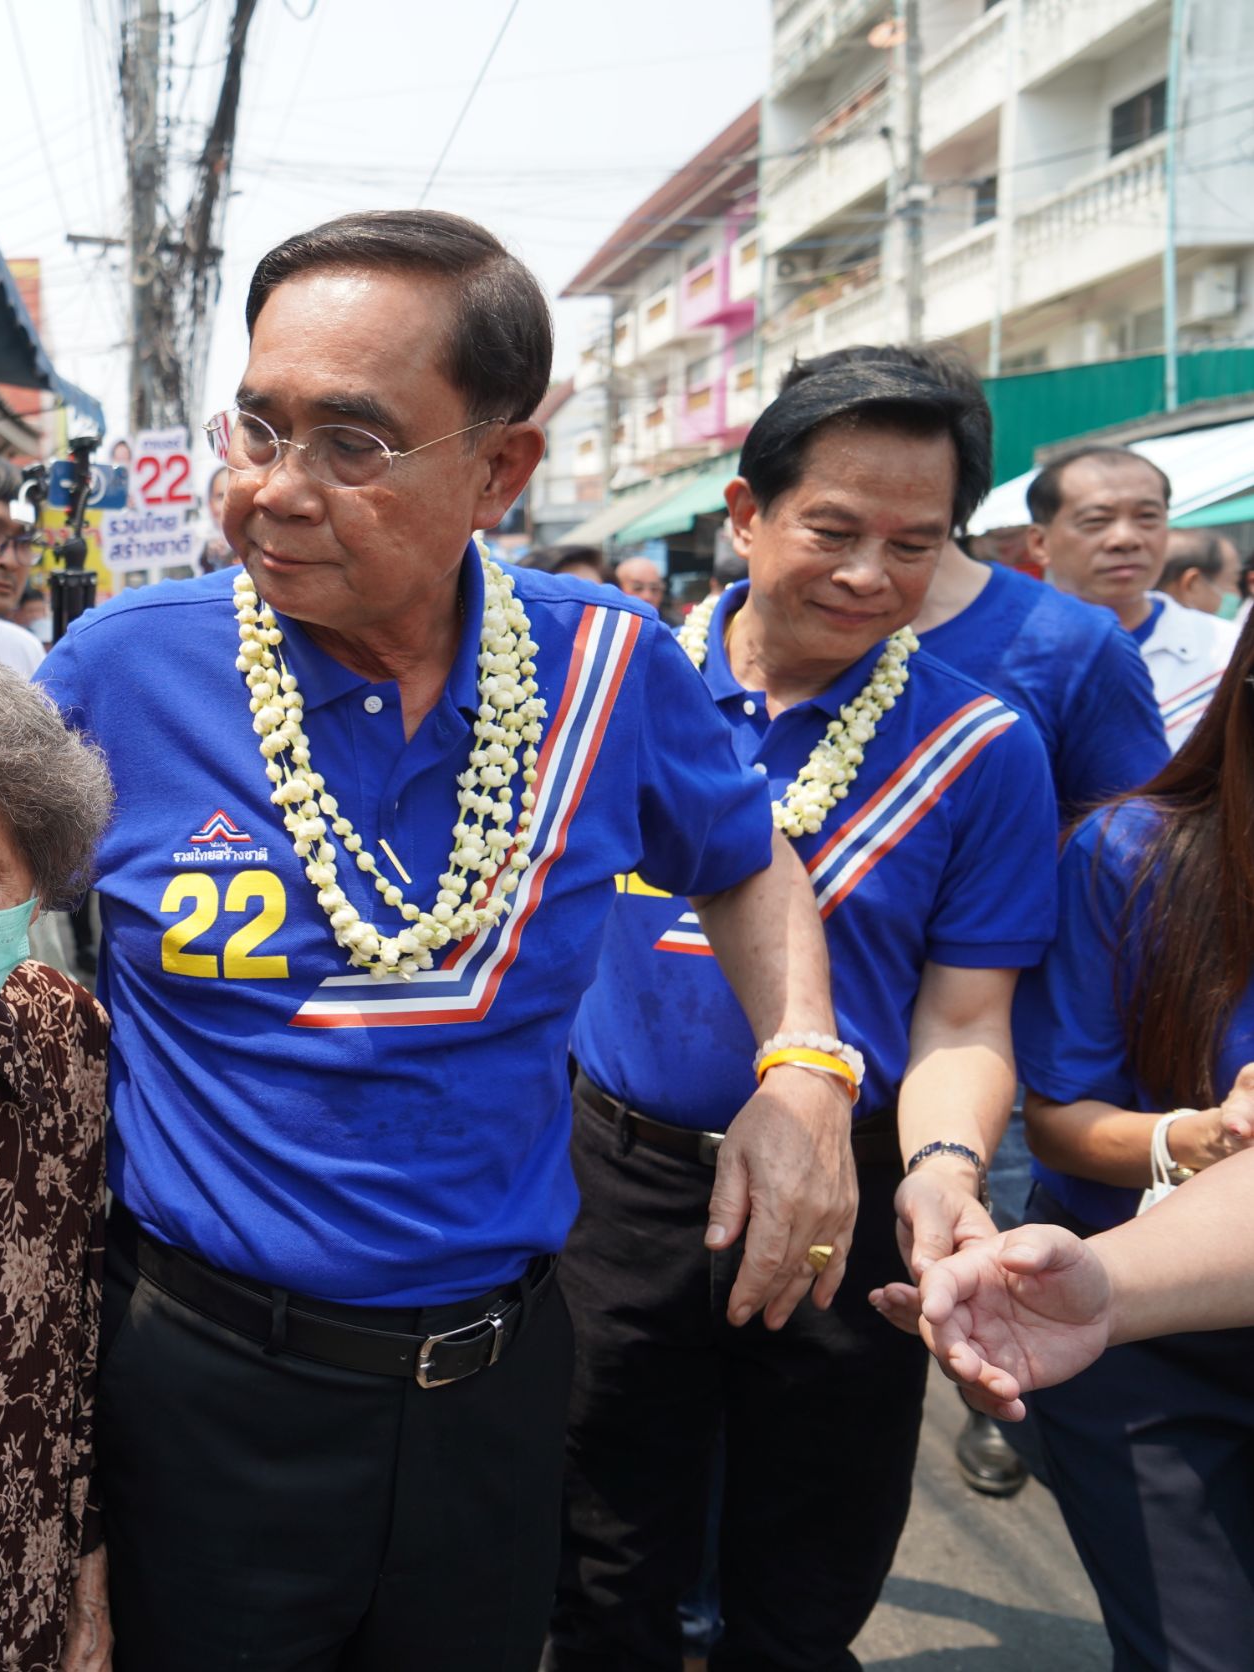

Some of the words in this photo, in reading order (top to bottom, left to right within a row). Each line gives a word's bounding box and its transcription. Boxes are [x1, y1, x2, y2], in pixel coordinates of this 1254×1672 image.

[137, 455, 192, 504] 22
[173, 847, 268, 862] รวมไทยสร้างชาติ
[160, 869, 289, 979] 22
